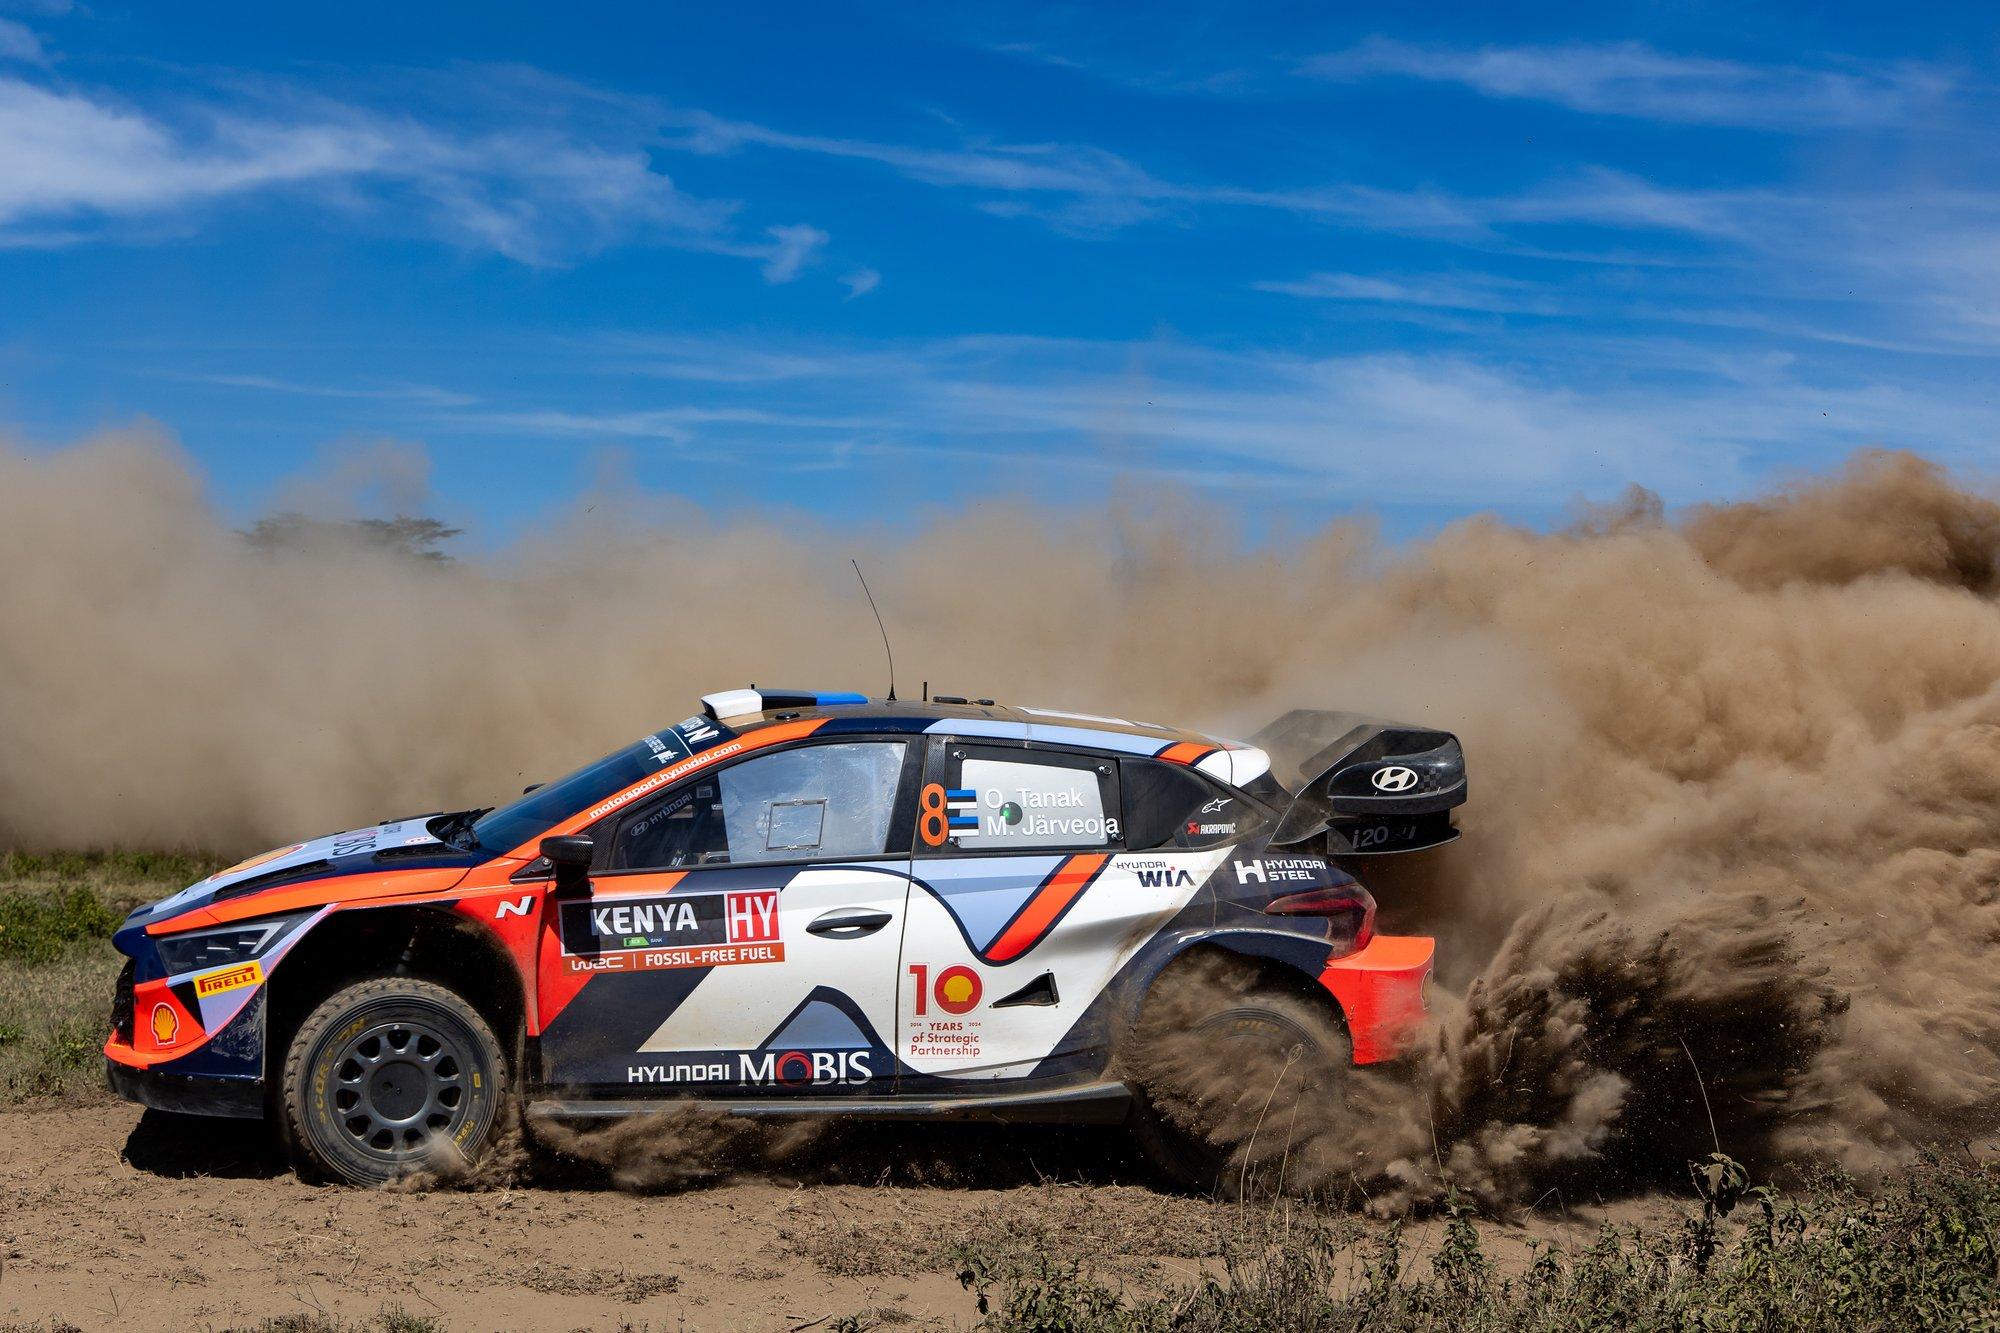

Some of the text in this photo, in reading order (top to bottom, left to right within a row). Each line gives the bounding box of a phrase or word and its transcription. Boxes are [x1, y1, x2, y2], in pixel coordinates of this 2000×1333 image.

[589, 743, 742, 819] motorsport.hyundai.com
[650, 793, 693, 825] HYUNDAI
[985, 788, 1084, 808] O. Tanak
[920, 783, 949, 846] 8
[987, 814, 1119, 840] M. Järveoja
[1352, 826, 1389, 848] i20
[1117, 861, 1167, 869] HYUNDAI
[1266, 860, 1327, 870] HYUNDAI
[1269, 870, 1316, 882] STEEL
[495, 895, 534, 918] N
[730, 895, 776, 939] HY
[591, 902, 699, 936] KENYA
[645, 949, 737, 967] FOSSIL-FREE
[740, 947, 776, 961] FUEL
[198, 966, 256, 993] PIRELLI
[929, 1022, 963, 1031] YEARS
[912, 1032, 980, 1046] of Strategic
[911, 1045, 981, 1057] Partnership
[627, 1050, 873, 1088] HYUNDAI MOBIS
